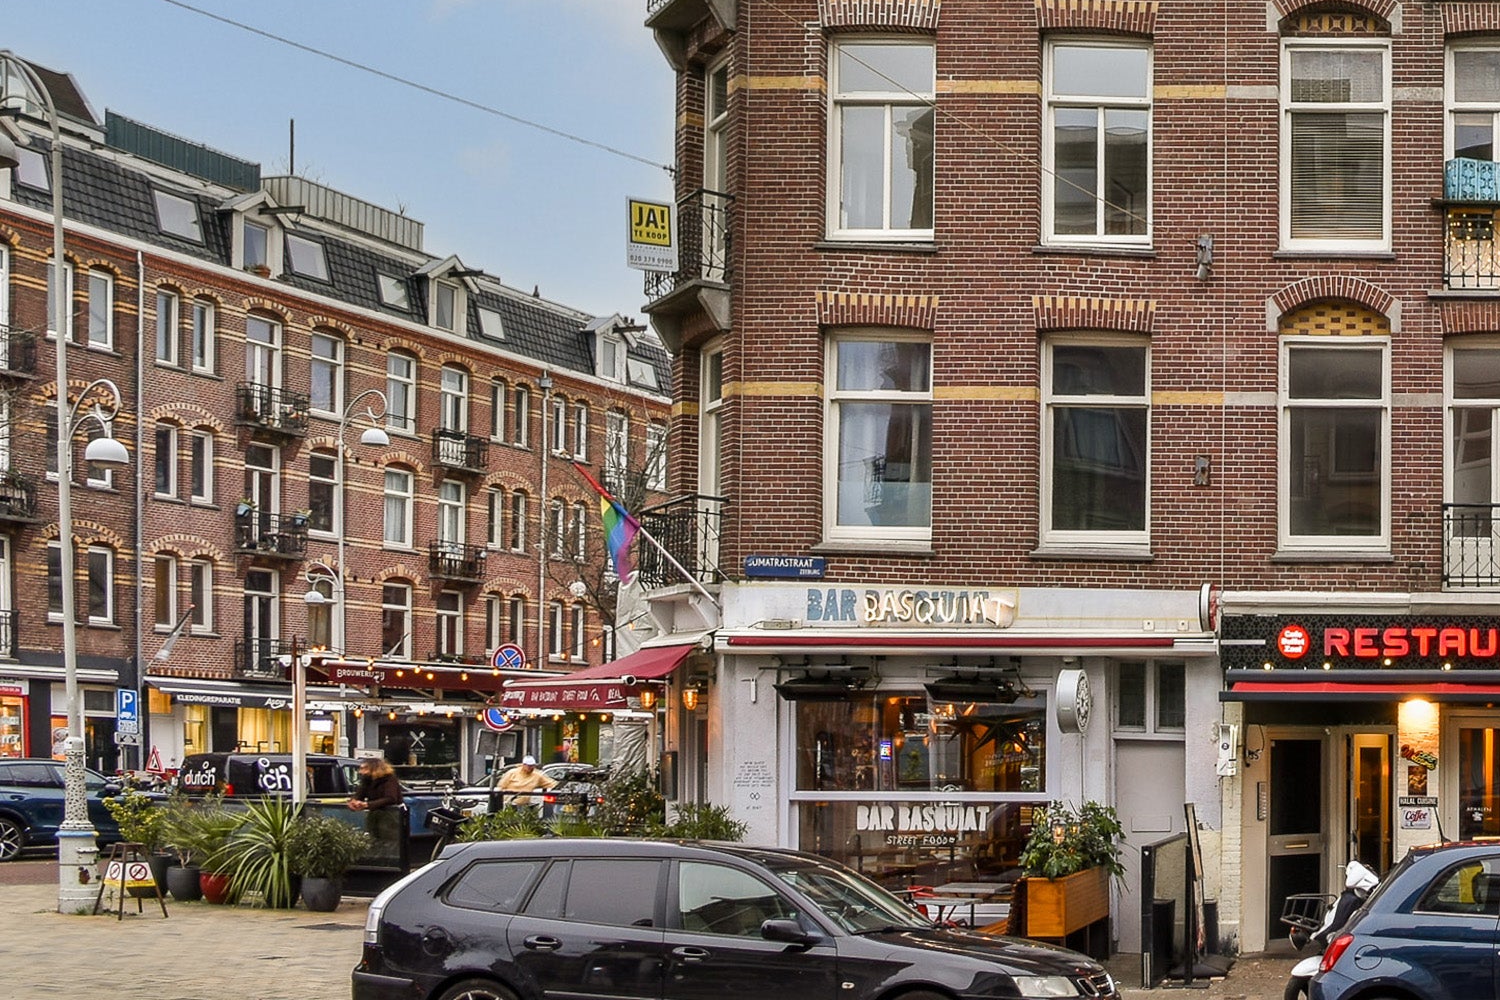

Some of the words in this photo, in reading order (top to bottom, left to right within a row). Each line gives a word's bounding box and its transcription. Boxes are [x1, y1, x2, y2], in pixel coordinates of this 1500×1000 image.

[634, 206, 666, 230] JA!
[634, 229, 643, 238] TE
[646, 231, 667, 240] KOOP
[807, 588, 857, 622] BAR
[864, 590, 1015, 626] BASQUIAT
[121, 691, 134, 709] P
[185, 768, 216, 786] dutch
[856, 805, 895, 831] BAR
[898, 805, 990, 832] BASQUIAT
[1405, 809, 1428, 822] Coffee
[886, 835, 918, 846] STREET
[923, 835, 948, 846] FOOD
